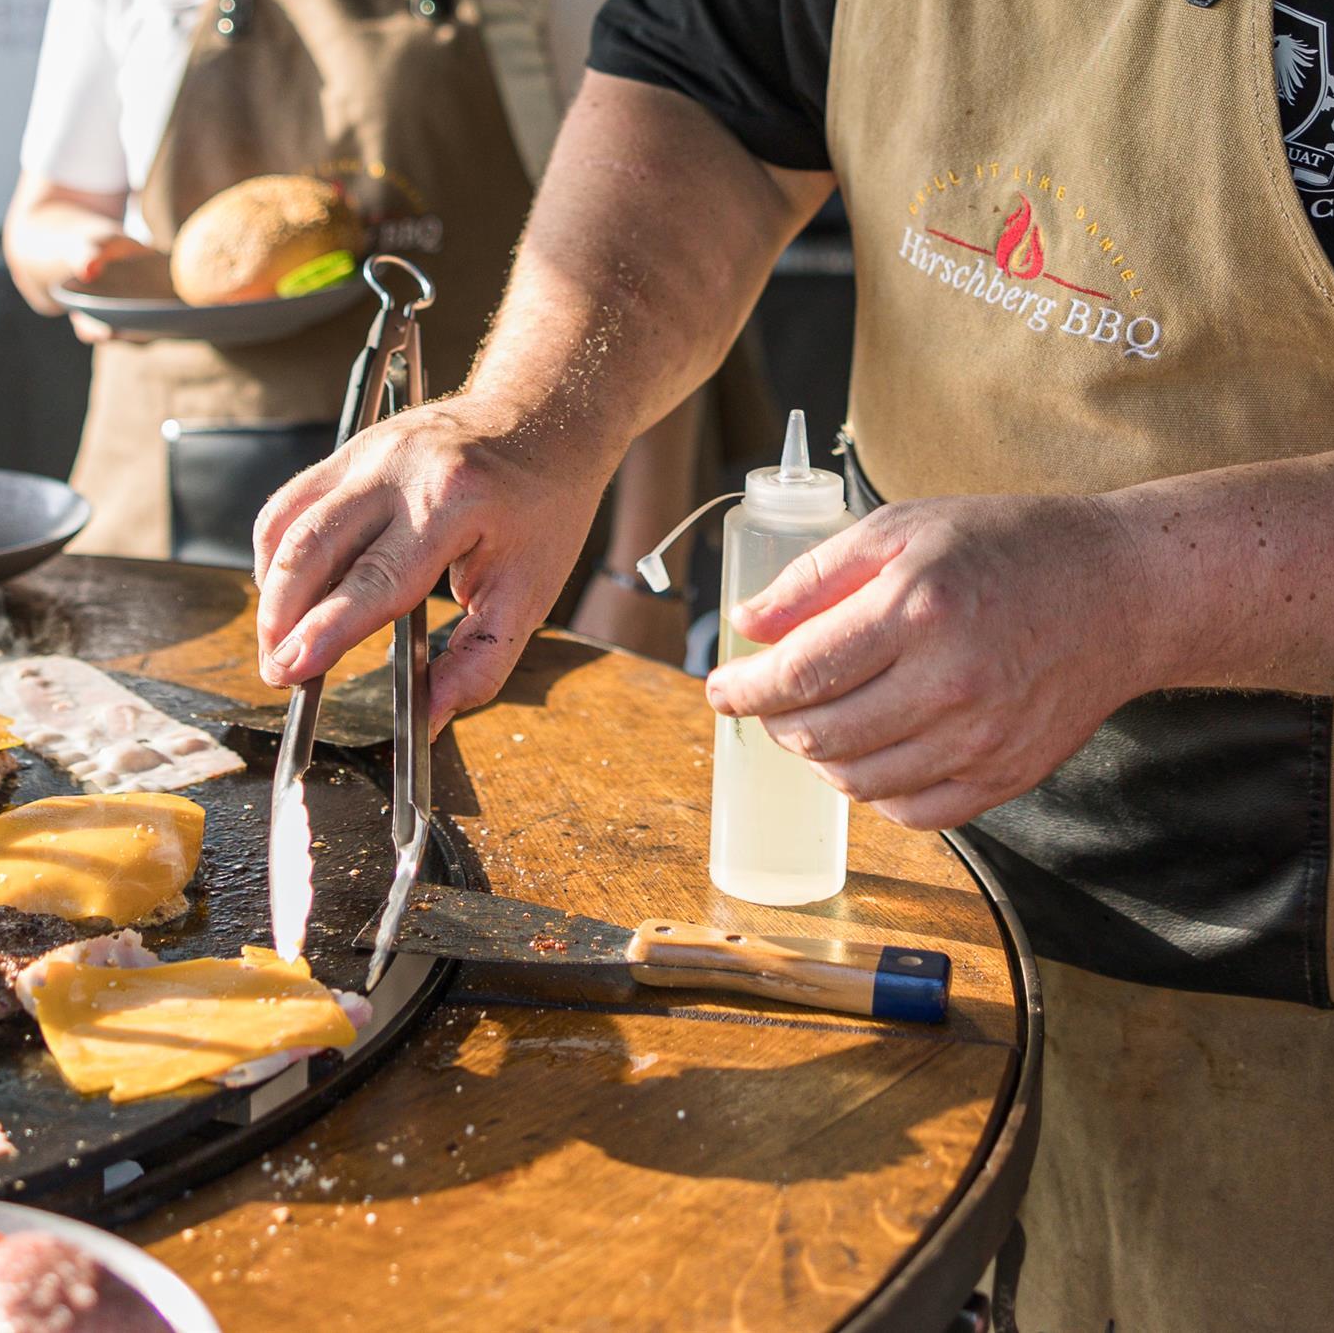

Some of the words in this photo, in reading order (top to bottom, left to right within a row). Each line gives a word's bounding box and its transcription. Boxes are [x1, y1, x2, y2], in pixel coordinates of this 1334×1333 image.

[1288, 147, 1325, 168] UAT
[898, 226, 1058, 332] Hirschberg
[1059, 297, 1163, 360] BBQ
[975, 162, 1000, 180] IT
[1012, 164, 1066, 201] LIKE
[1075, 205, 1144, 301] DANIEL
